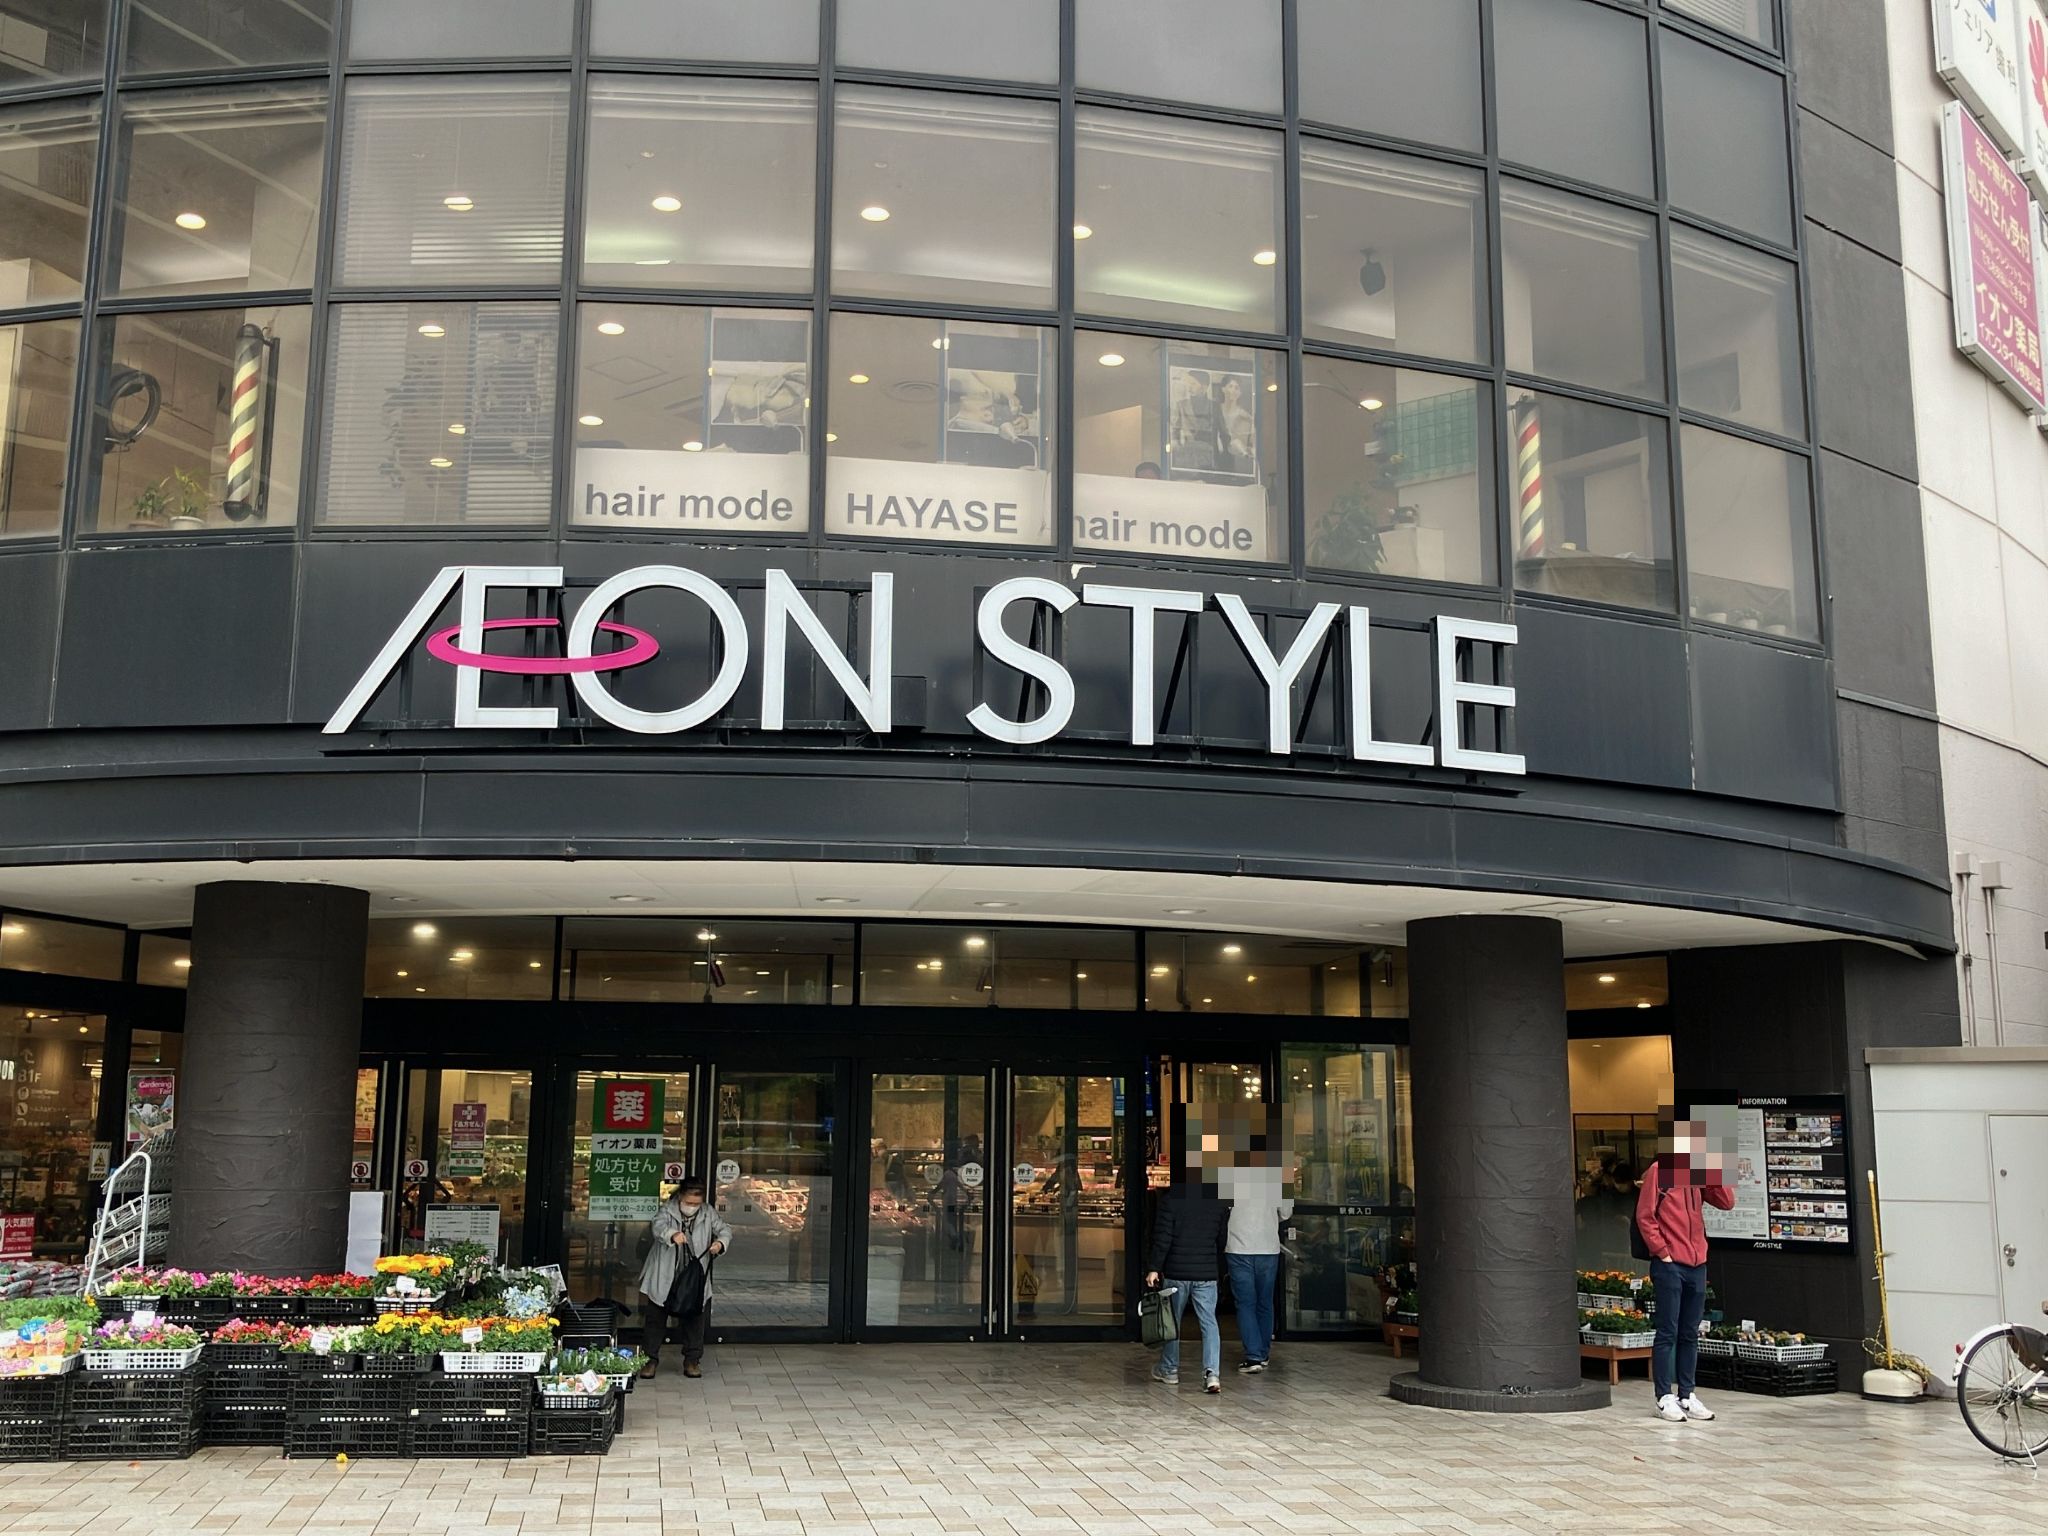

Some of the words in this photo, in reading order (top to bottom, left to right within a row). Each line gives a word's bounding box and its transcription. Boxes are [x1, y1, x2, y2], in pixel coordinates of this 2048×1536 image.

[1967, 163, 2030, 264] 処方せん受付
[1976, 283, 2040, 369] イオン薬局
[585, 483, 665, 517] hair
[679, 489, 793, 522] mode
[847, 492, 1018, 534] HAYASE
[1150, 519, 1253, 551] mode
[966, 576, 1526, 775] STYLE
[0, 1059, 15, 1080] OR
[138, 1081, 172, 1089] Gardening
[159, 1087, 172, 1095] Fair
[612, 1090, 646, 1122] 薬
[597, 1138, 657, 1149] イオン薬局
[594, 1158, 657, 1173] 処方せん
[721, 1164, 736, 1173] 押す
[966, 1167, 980, 1175] 押す
[609, 1176, 640, 1193] 受付
[524, 1358, 535, 1367] 01
[588, 1399, 600, 1408] 02
